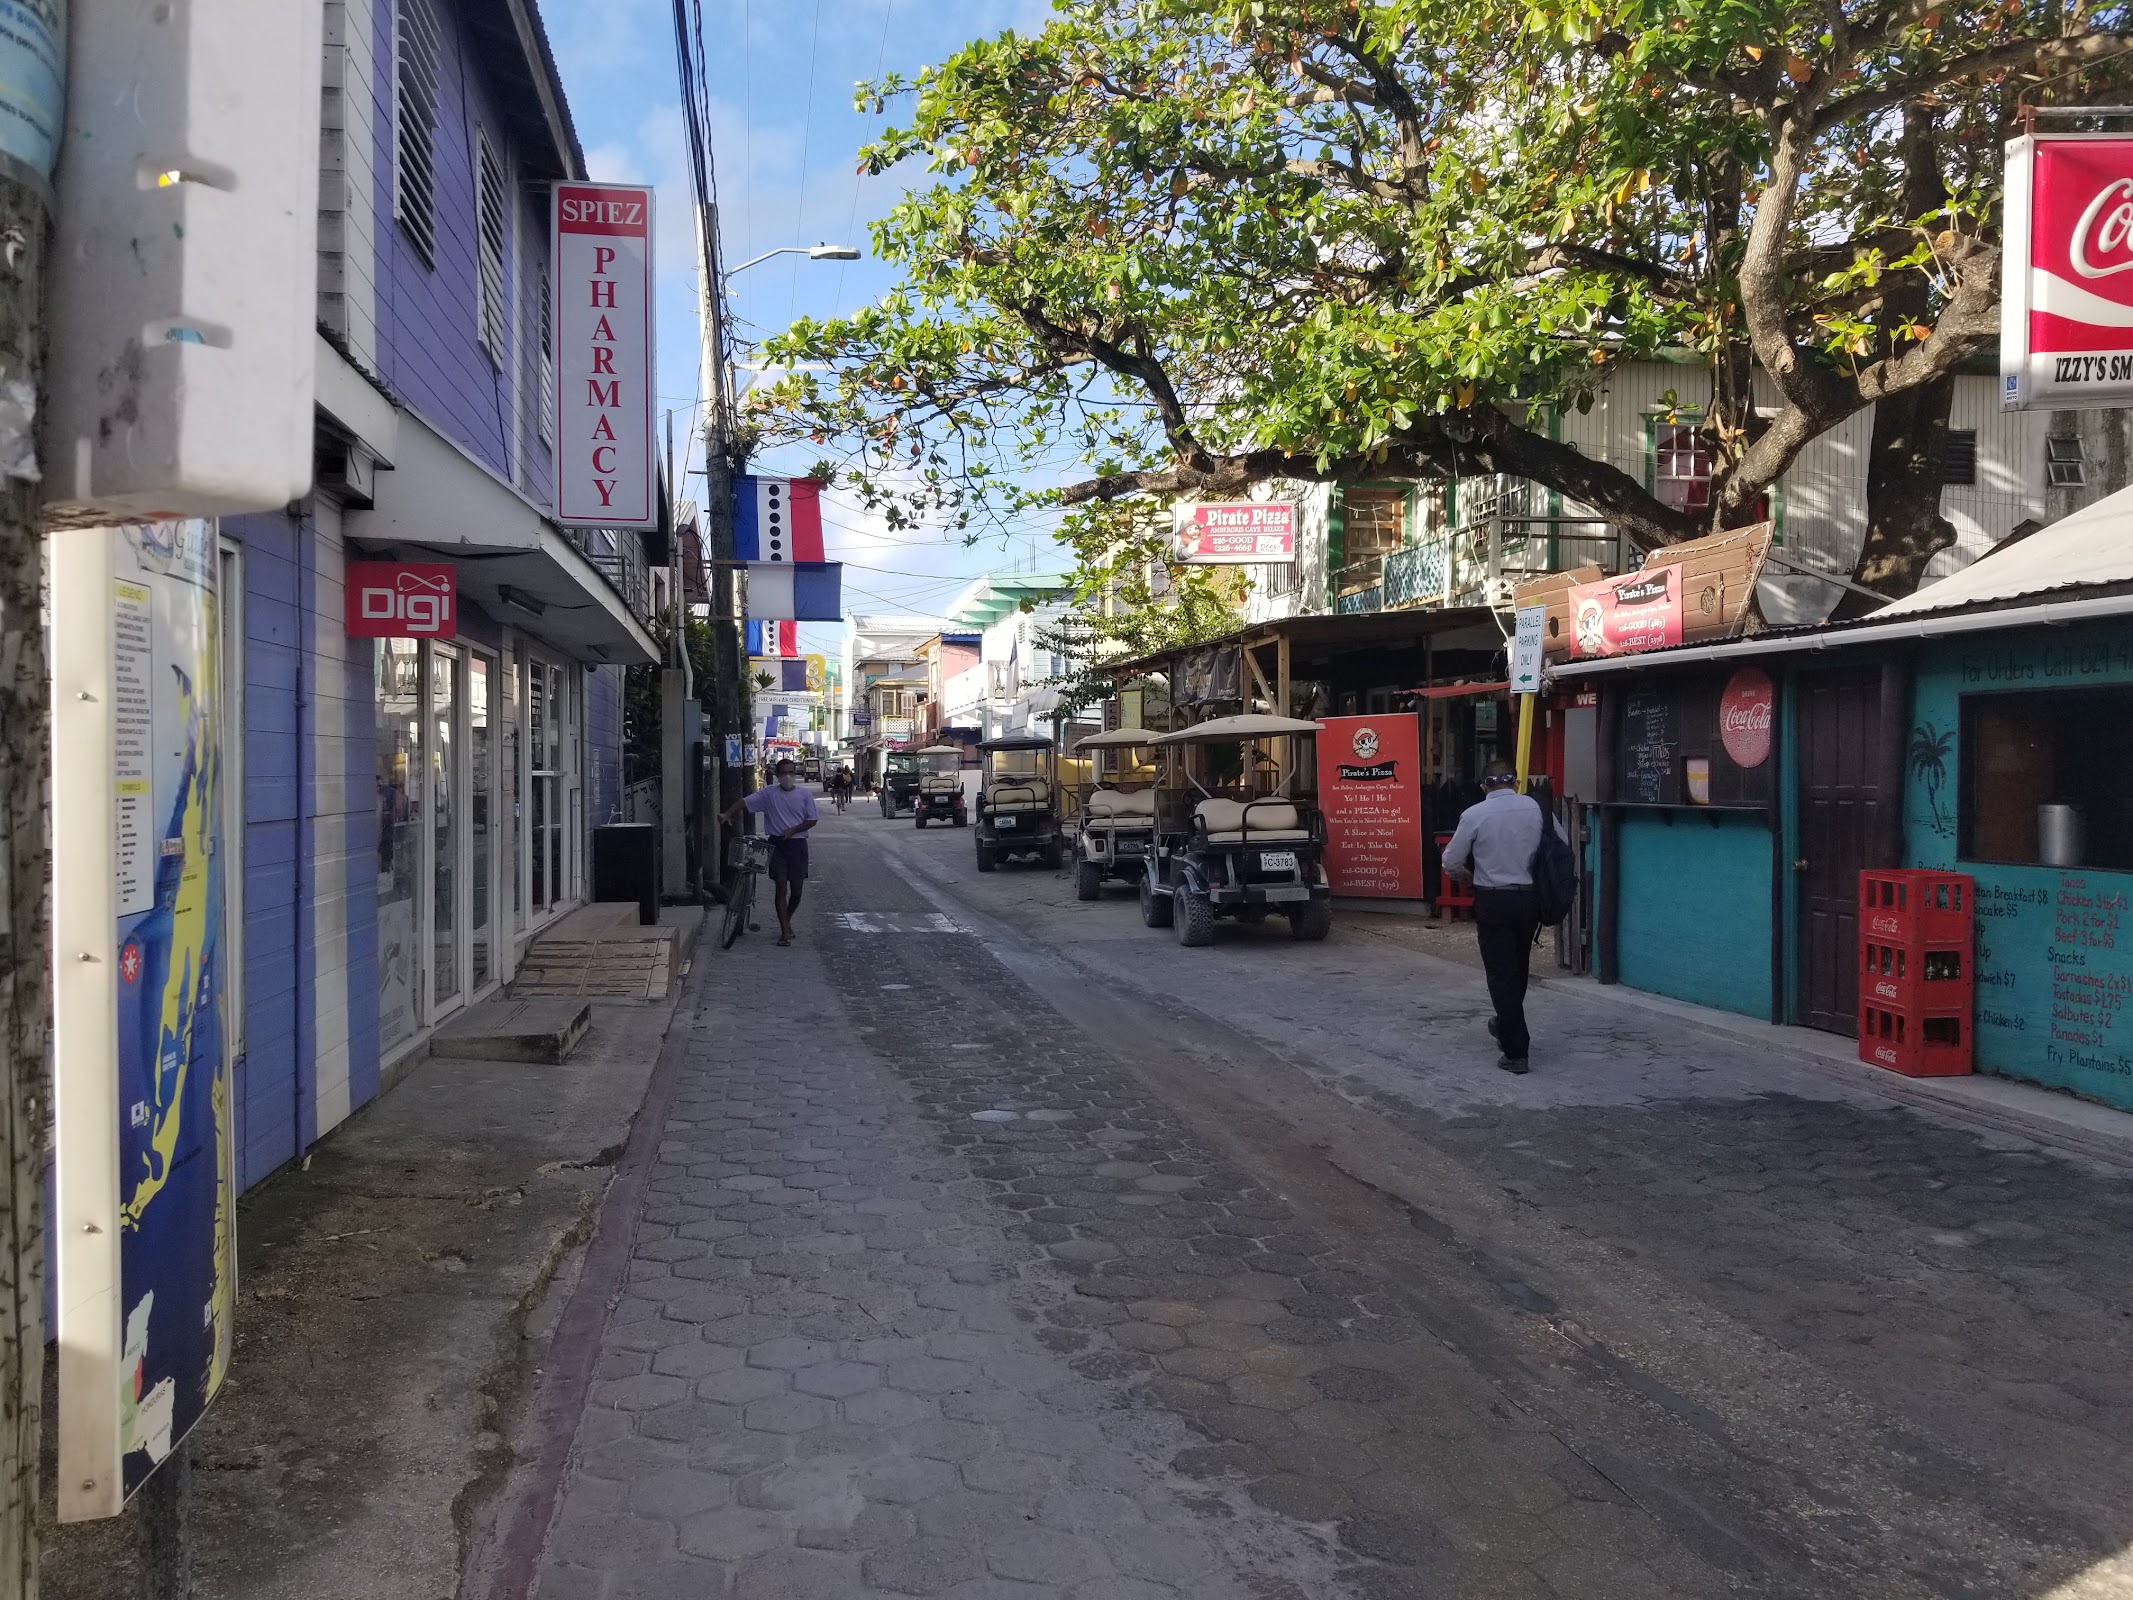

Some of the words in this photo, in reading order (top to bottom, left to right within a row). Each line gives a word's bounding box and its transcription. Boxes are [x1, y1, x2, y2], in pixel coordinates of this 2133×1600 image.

[562, 199, 643, 225] SPIEZ
[586, 246, 621, 507] PHARMACY
[2055, 356, 2106, 383] IZZY'S
[2110, 355, 2133, 380] SM
[1206, 509, 1249, 526] Pirate
[1251, 508, 1289, 526] Pizza
[1210, 526, 1244, 534] AMBERGRIS
[1618, 585, 1645, 600] Pirate's
[1645, 584, 1665, 596] Pizza
[362, 580, 450, 631] Digi
[1520, 615, 1541, 630] PARALLEL
[1519, 634, 1538, 648] PARKING
[1521, 653, 1533, 666] ONLY
[1987, 651, 2034, 681] Orders
[1342, 768, 1369, 777] Pirate's
[1372, 768, 1392, 776] Pizza
[1268, 857, 1294, 868] C-3783
[1360, 854, 1388, 864] Delivery
[1378, 880, 1399, 890] (2378)
[2060, 872, 2086, 888] Tacos
[1994, 885, 2036, 903] Breakfast
[2038, 890, 2048, 906] $8
[2056, 890, 2093, 908] Chicken
[2007, 904, 2018, 918] $5
[2056, 908, 2080, 925] Pork
[2083, 912, 2089, 926] 2
[2090, 912, 2105, 928] for
[2108, 912, 2120, 929] $1
[2055, 927, 2078, 944] Beef
[2048, 946, 2086, 966] Snacks
[2004, 970, 2016, 988] $7
[2054, 964, 2105, 989] Garnaches
[2052, 984, 2092, 1005] Tostadas
[1983, 1010, 2012, 1030] Chicken
[2014, 1014, 2024, 1030] $2
[2052, 1002, 2094, 1026] Salbutes
[2098, 1010, 2112, 1029] $2
[2051, 1022, 2090, 1046] Panades
[2092, 1030, 2104, 1048] $1
[2048, 1045, 2064, 1065] Fry
[2070, 1048, 2115, 1074] Plantains
[2118, 1056, 2132, 1076] $5
